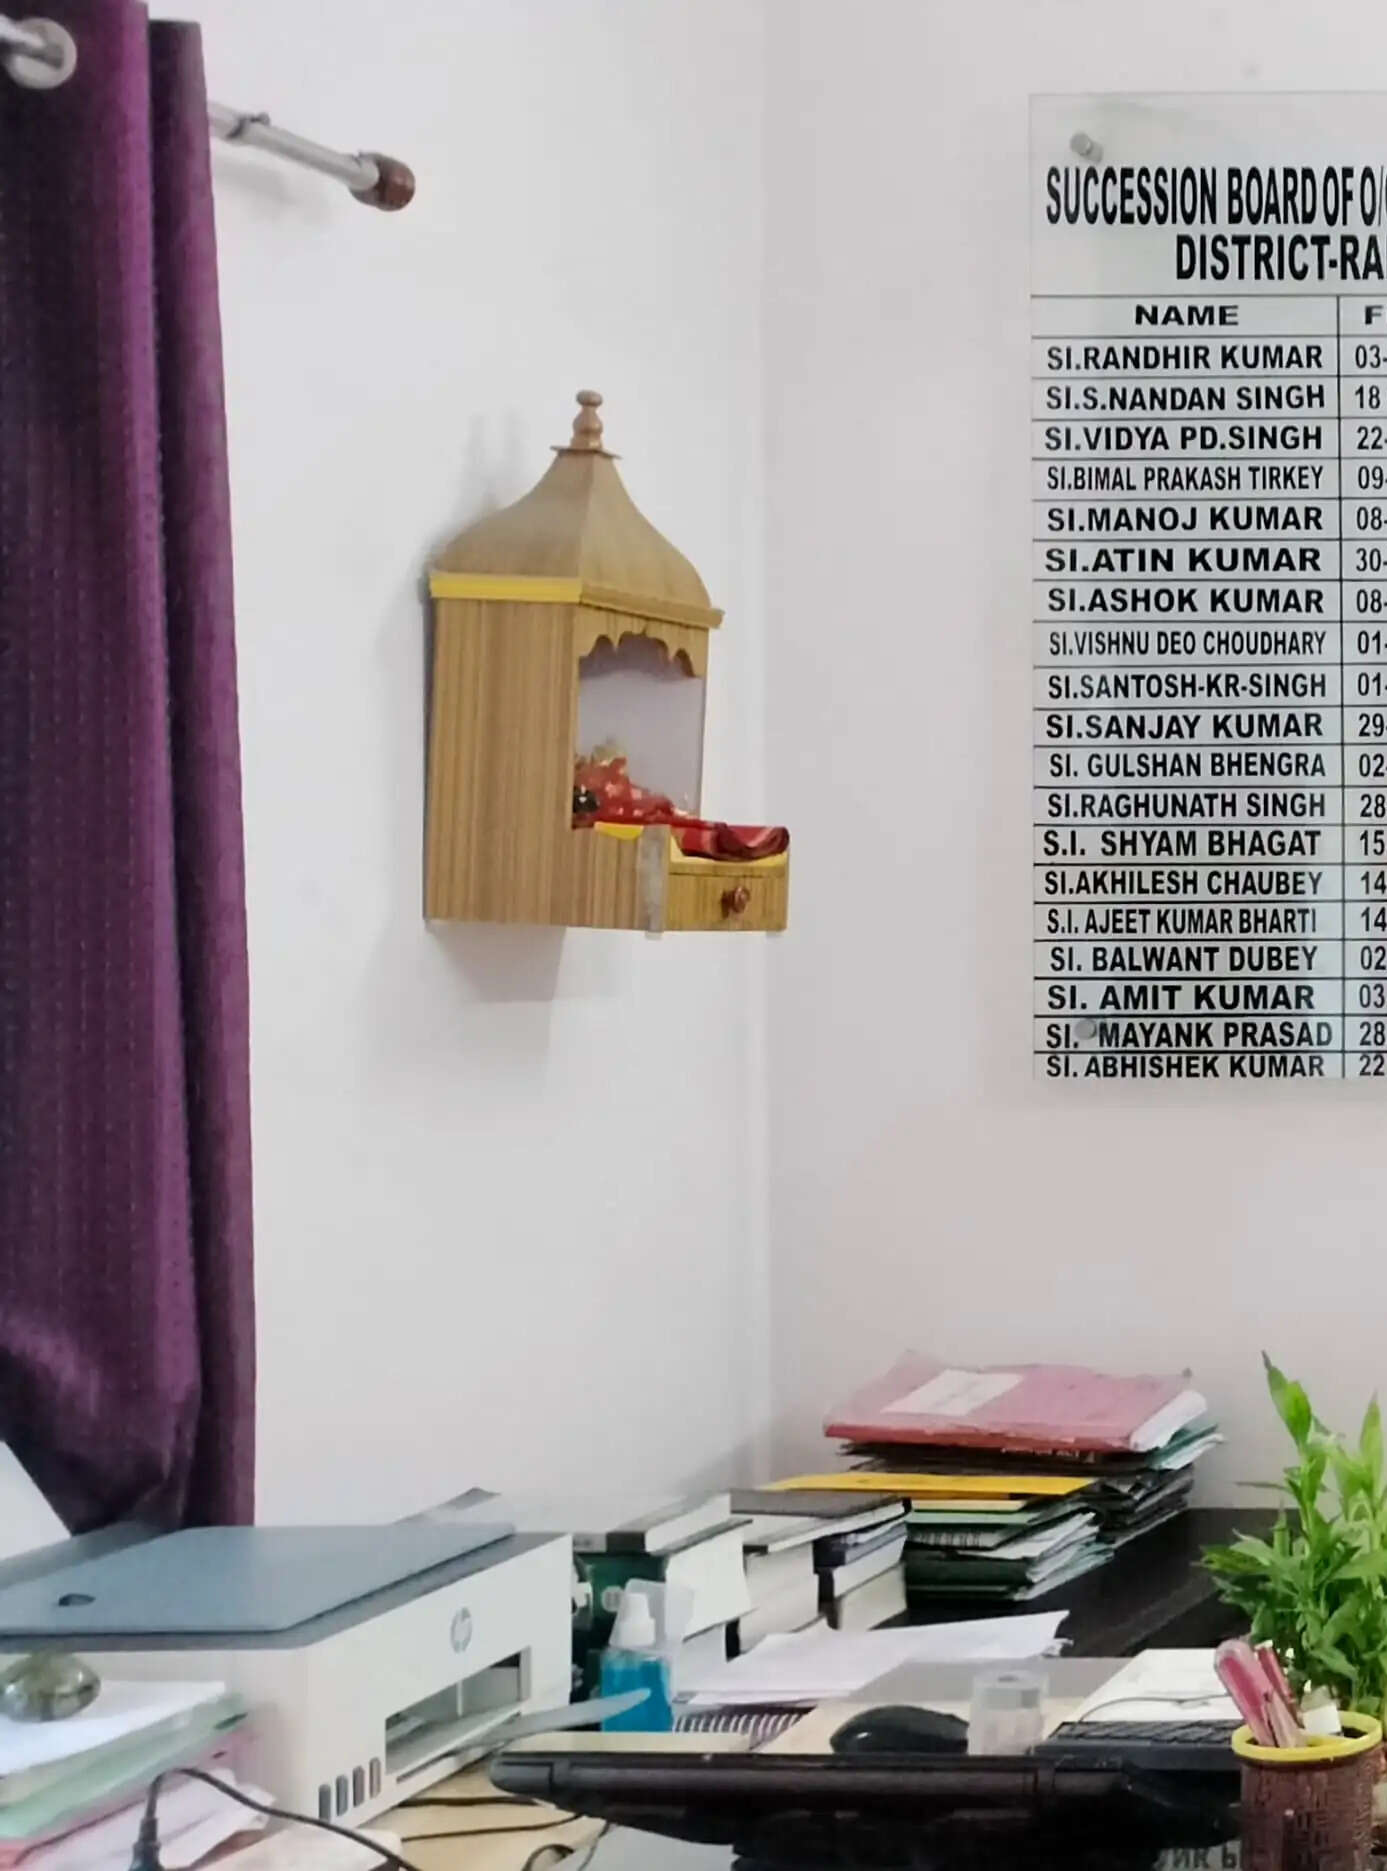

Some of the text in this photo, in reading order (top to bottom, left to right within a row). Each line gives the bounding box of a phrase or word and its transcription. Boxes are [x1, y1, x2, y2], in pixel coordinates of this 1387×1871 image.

[1046, 165, 1217, 226] SUCCESSION
[1228, 166, 1317, 225] BOARD
[1323, 166, 1354, 227] OF
[1135, 304, 1238, 326] NAME
[1048, 345, 1210, 370] SI.RANDHIR
[1221, 345, 1323, 369] KUMAR
[1237, 384, 1324, 410] SINGH
[1045, 426, 1169, 451] SI.VIDYA
[1181, 425, 1321, 450] PD.SINGH
[1047, 466, 1136, 491] SI.BIMAL
[1144, 466, 1240, 491] PRAKASH
[1248, 465, 1323, 490] TIRKEY
[1048, 507, 1196, 532] SI.MANOJ
[1210, 506, 1323, 530] KUMAR
[1045, 548, 1173, 572] SI.ATIN
[1189, 547, 1321, 572] KUMAR
[1048, 588, 1198, 612] SI.ASHOK
[1211, 588, 1323, 613] KUMAR
[1050, 631, 1149, 656] SI.VISHNU
[1157, 631, 1196, 655] DEO
[1204, 631, 1326, 656] CHOUDHARY
[1049, 673, 1325, 699] SI.SANTOSH-KR-SINGH
[1046, 714, 1201, 739] SI.SANJAY
[1213, 713, 1323, 738] KUMAR
[1050, 753, 1078, 778] SI.
[1088, 753, 1201, 777] GULSHAN
[1211, 752, 1325, 776] BHENGRA
[1048, 793, 1236, 818] SI.RAGHUNATH
[1247, 793, 1325, 817] SINGH
[1043, 829, 1085, 856] S.I.
[1101, 830, 1196, 856] SHYAM
[1208, 830, 1321, 856] BHAGAT
[1045, 870, 1197, 895] SI.AKHILESH
[1207, 871, 1322, 895] CHAUBEY
[1047, 908, 1078, 934] S.I.
[1085, 909, 1151, 934] AJEET
[1157, 909, 1232, 934] KUMAR
[1239, 908, 1316, 933] BHARTI
[1050, 946, 1082, 972] SI.
[1093, 946, 1219, 971] BALWANT
[1230, 946, 1317, 971] DUBEY
[1048, 985, 1087, 1010] SI.
[1099, 985, 1181, 1010] AMIT
[1195, 985, 1314, 1010] KUMAR
[1046, 1022, 1079, 1049] SI.
[1098, 1021, 1214, 1048] MAYANK
[1224, 1021, 1332, 1047] PRASAD
[1046, 1055, 1079, 1077] SI.
[1084, 1055, 1219, 1078] ABHISHEK
[1230, 1055, 1325, 1077] KUMAR
